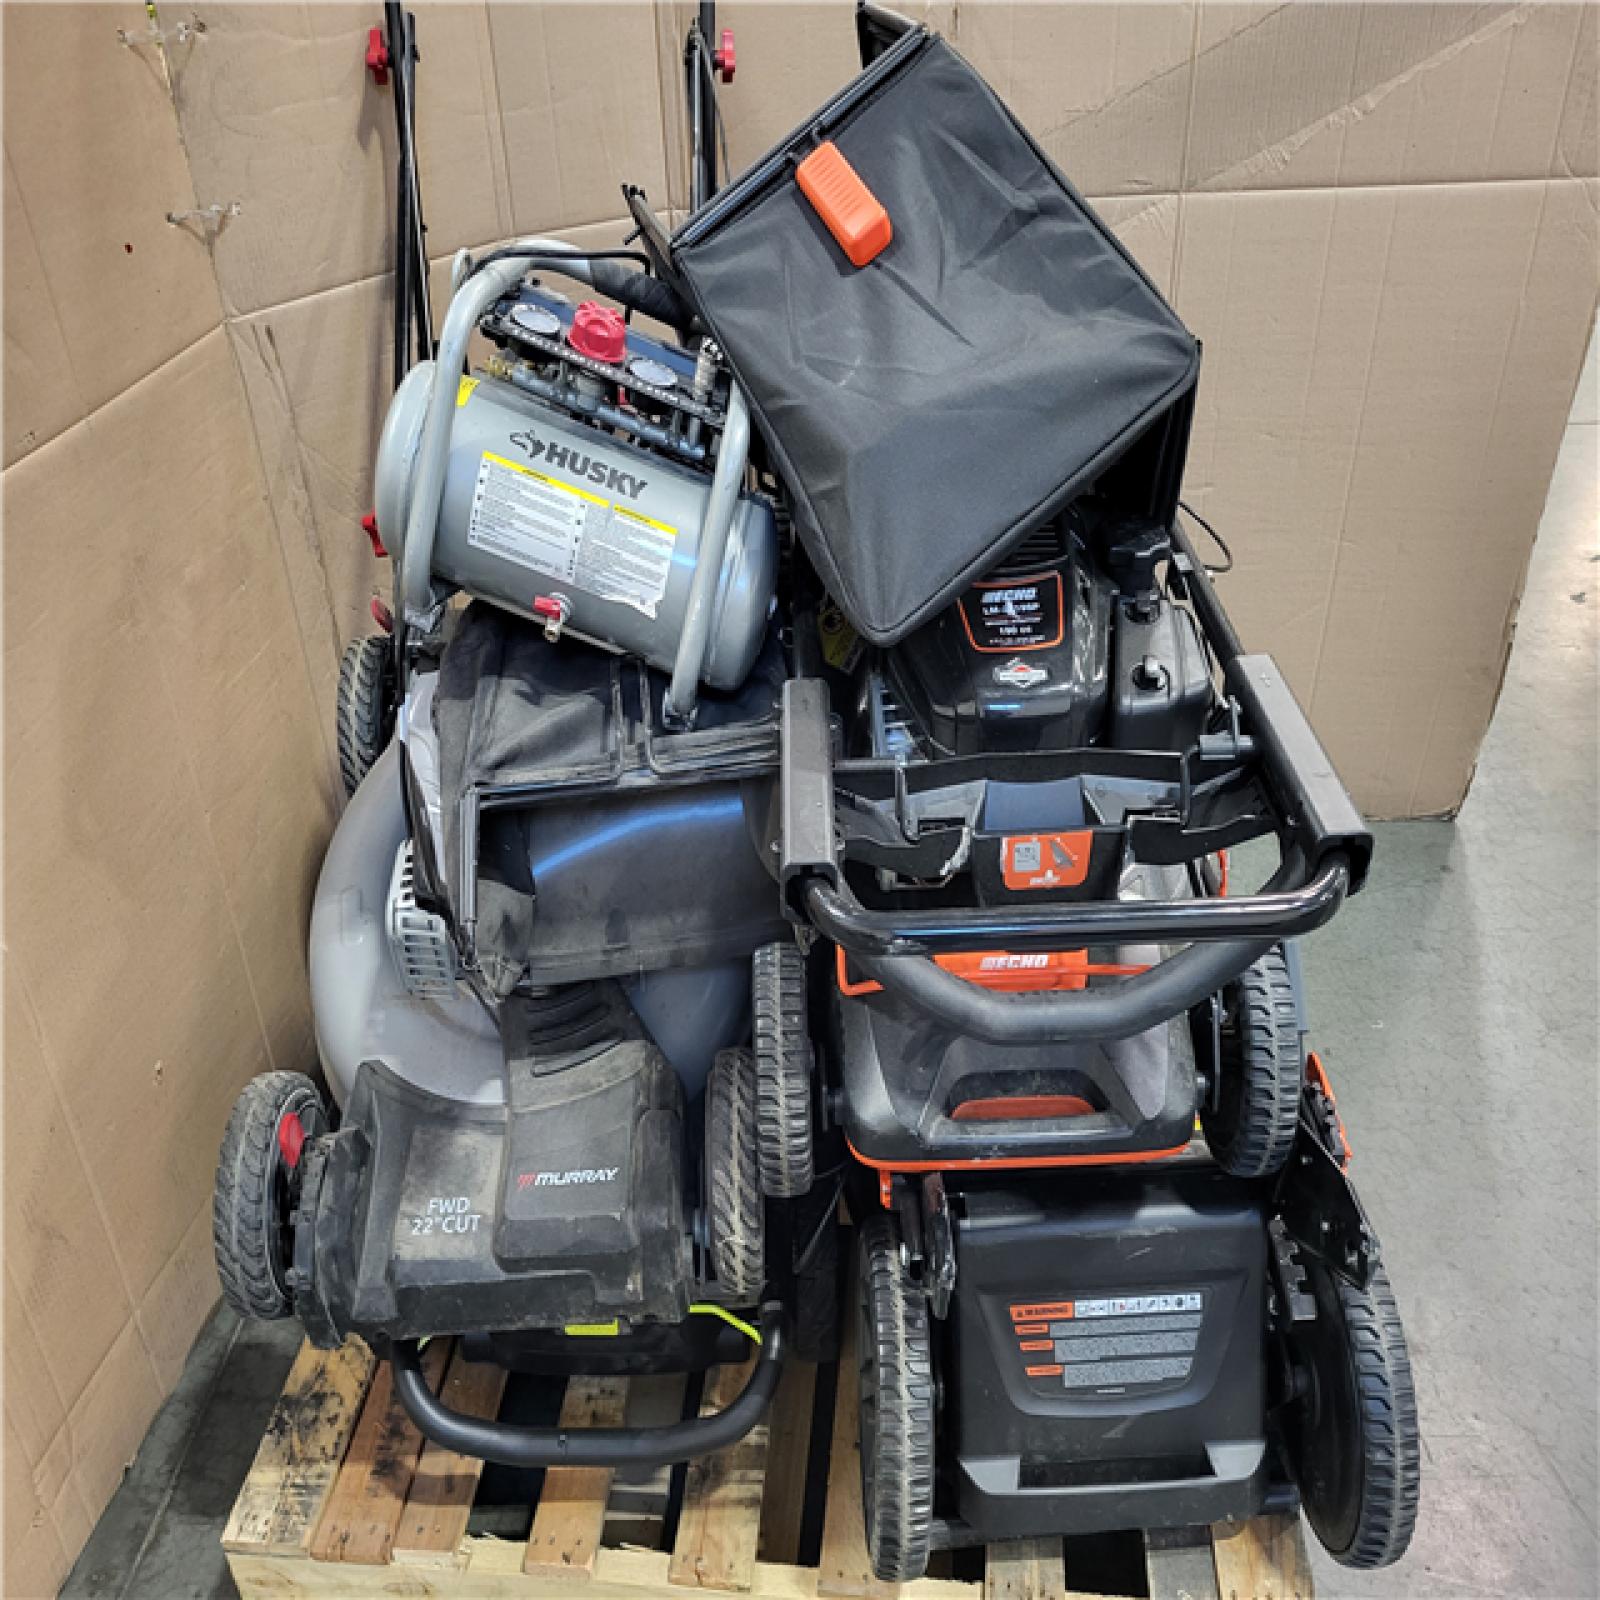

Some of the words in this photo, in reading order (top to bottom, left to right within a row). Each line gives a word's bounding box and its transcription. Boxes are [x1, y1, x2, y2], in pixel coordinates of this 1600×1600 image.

[545, 442, 648, 500] HUSKY
[994, 954, 1048, 970] ECHO
[534, 1167, 620, 1186] MURRAY
[428, 1196, 471, 1214] FWD
